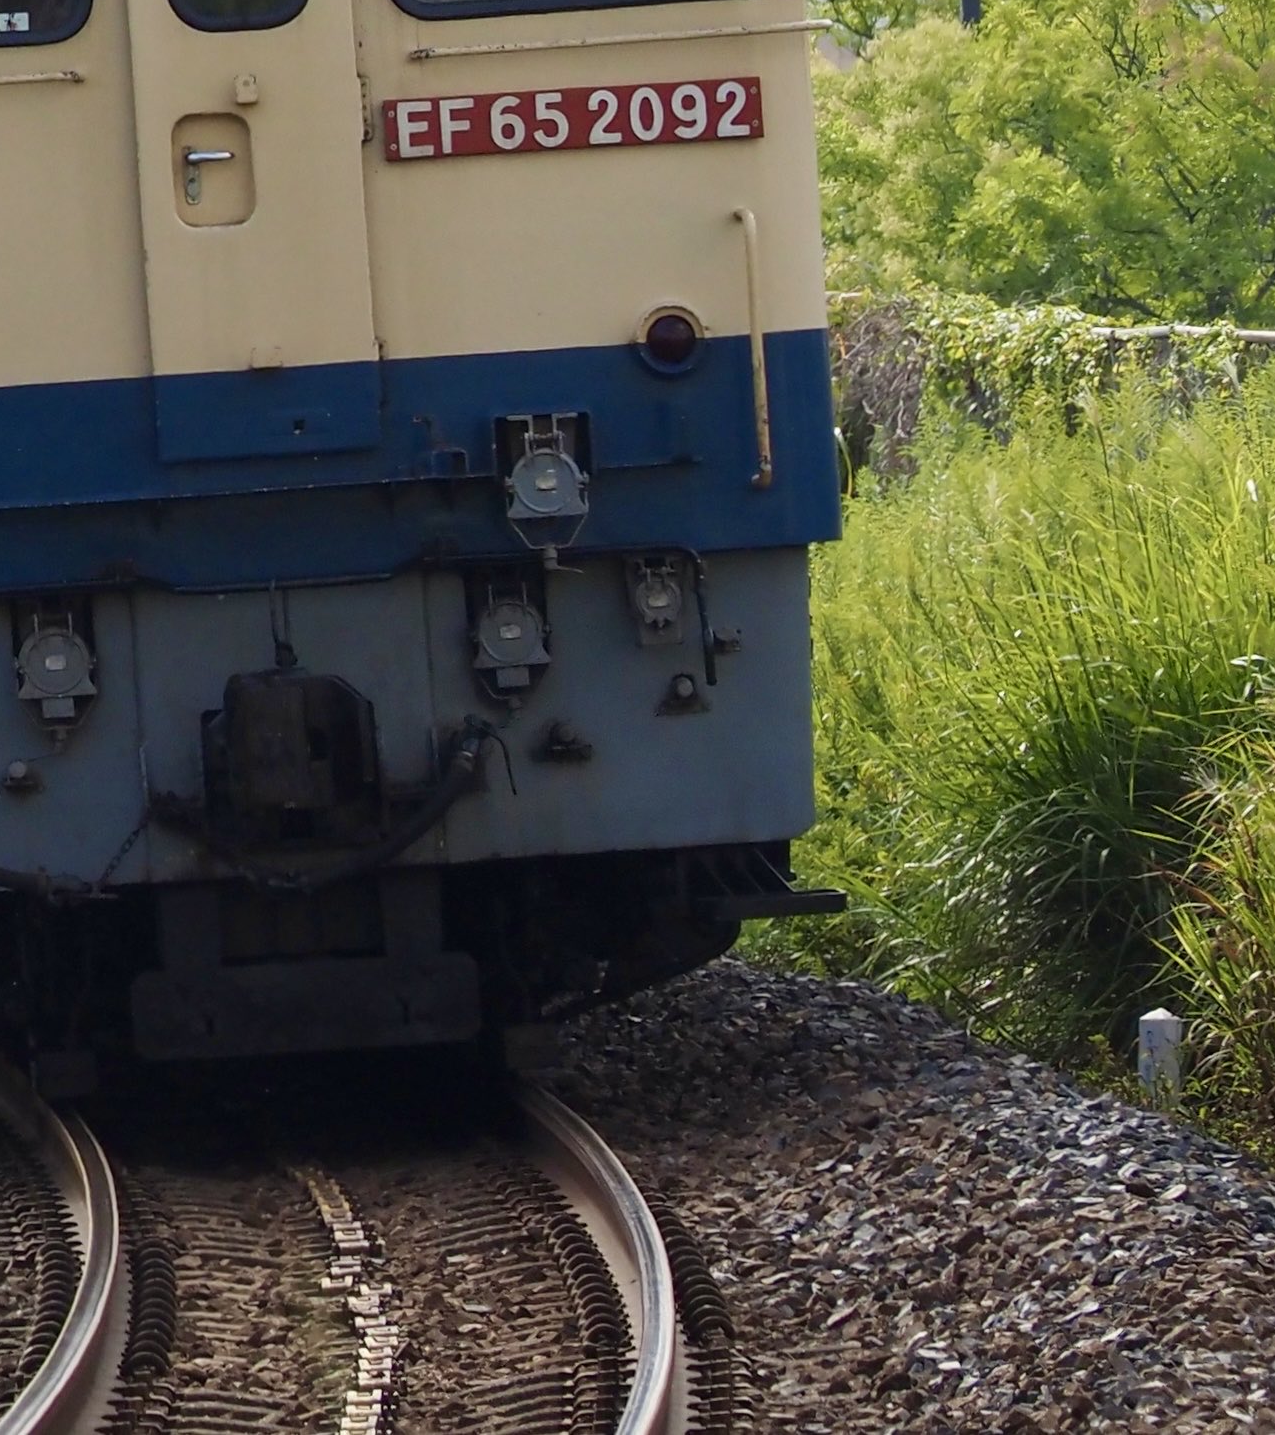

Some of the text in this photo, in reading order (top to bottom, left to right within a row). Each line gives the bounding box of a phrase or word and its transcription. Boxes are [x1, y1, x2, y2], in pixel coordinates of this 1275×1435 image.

[396, 80, 751, 159] EF 65 2092
